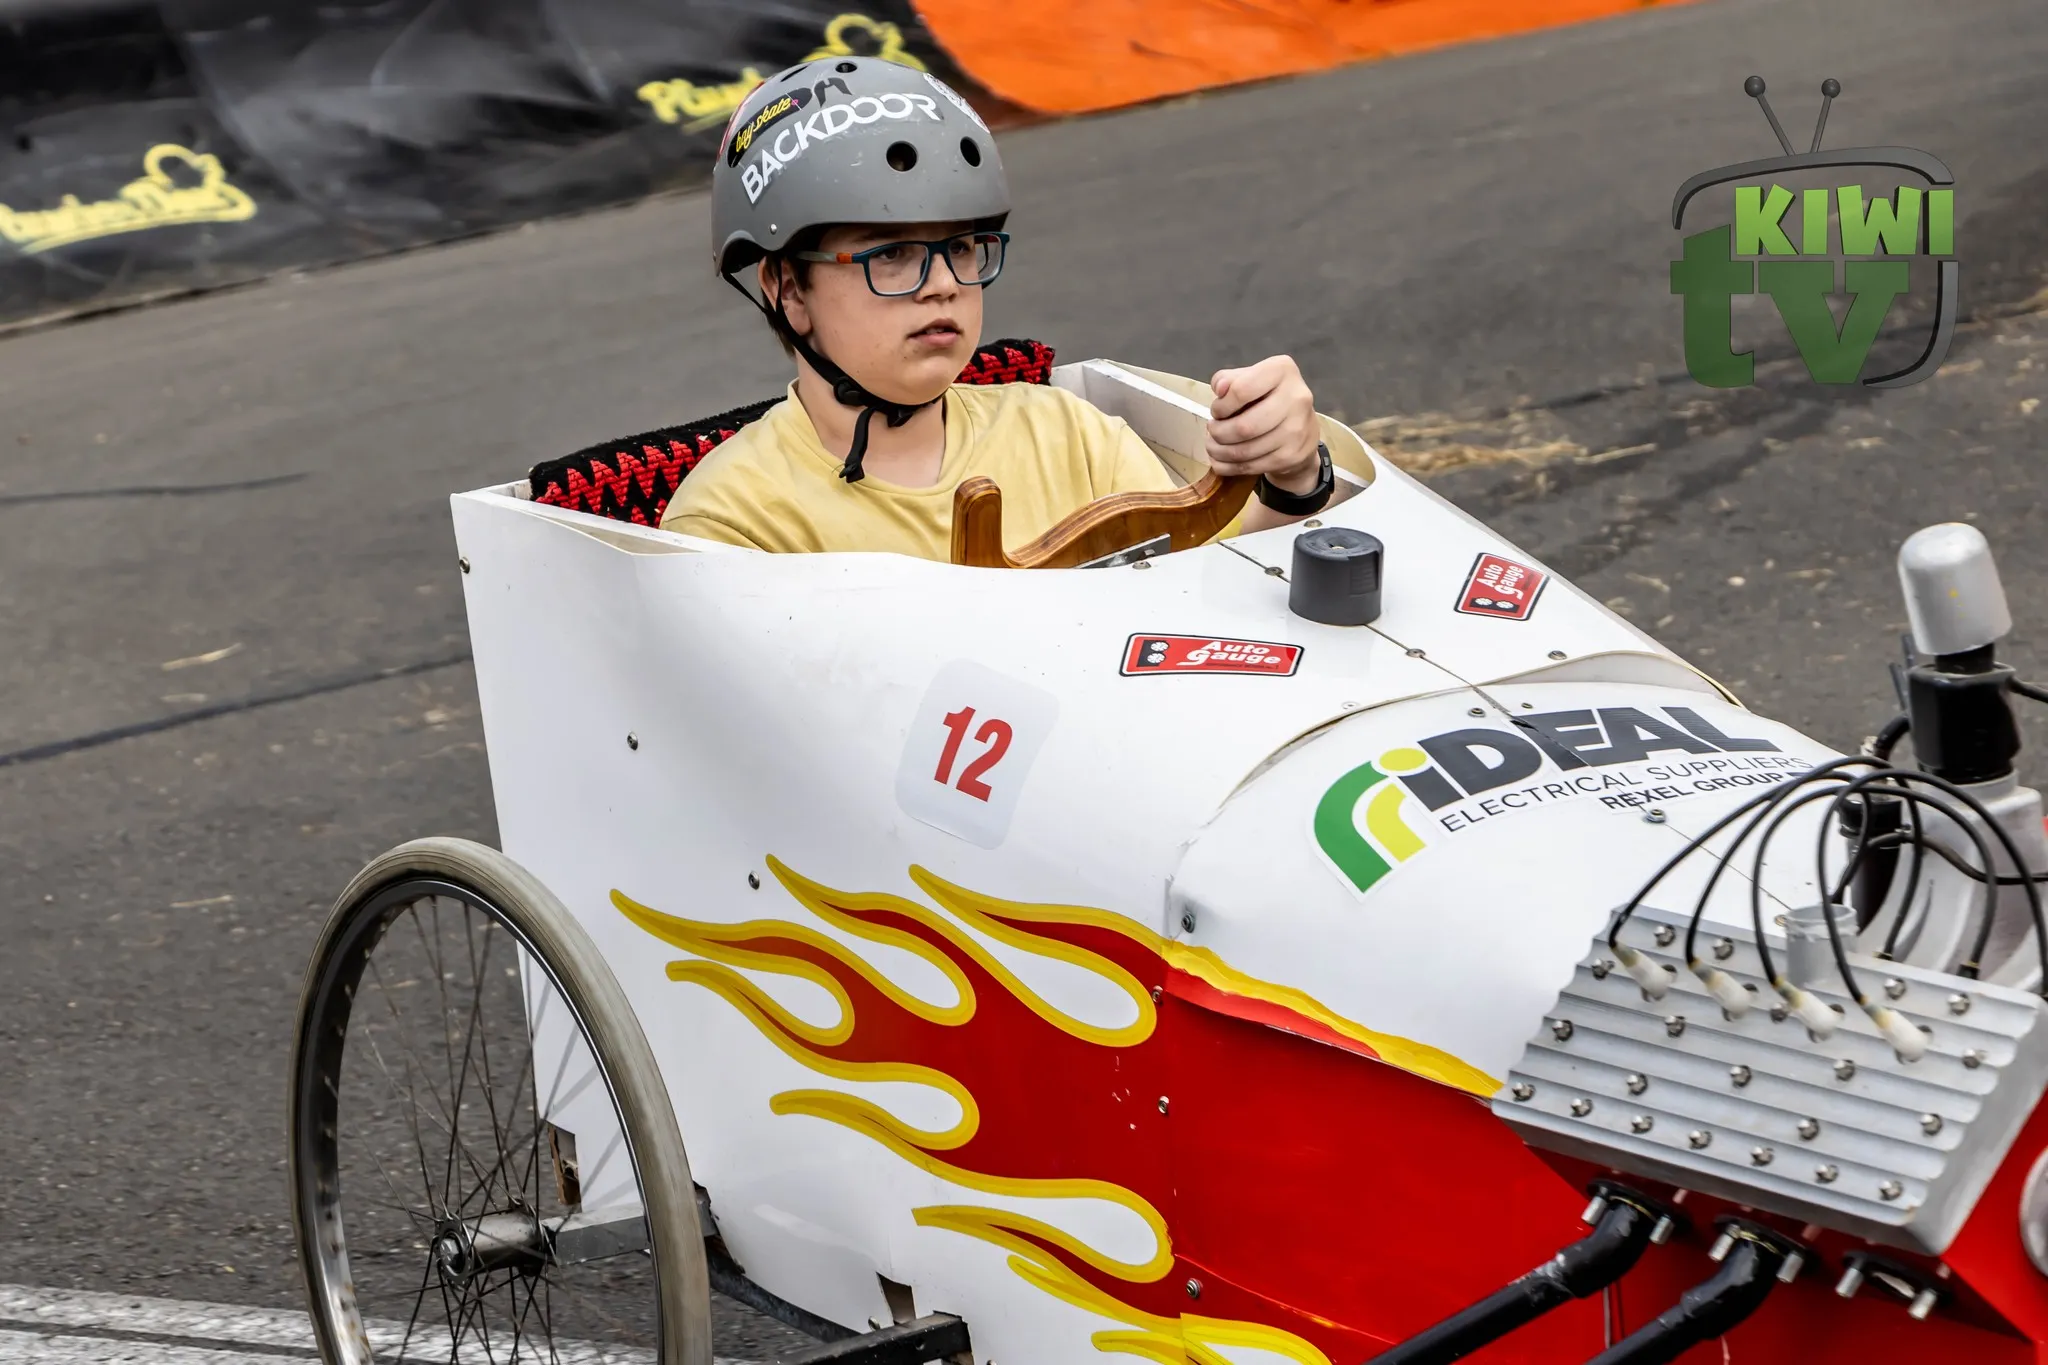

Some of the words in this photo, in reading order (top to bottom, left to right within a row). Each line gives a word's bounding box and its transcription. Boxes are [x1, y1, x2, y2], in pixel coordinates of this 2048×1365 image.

[736, 124, 755, 152] bay
[741, 93, 941, 204] BACKDOOR
[1476, 564, 1504, 588] Auto
[1201, 640, 1271, 655] Auto
[934, 706, 1013, 803] 12
[1440, 771, 1643, 832] ELECTRICAL
[1647, 756, 1814, 781] SUPPLIERS
[1598, 784, 1695, 810] REXEL
[1693, 771, 1787, 793] GROUP
